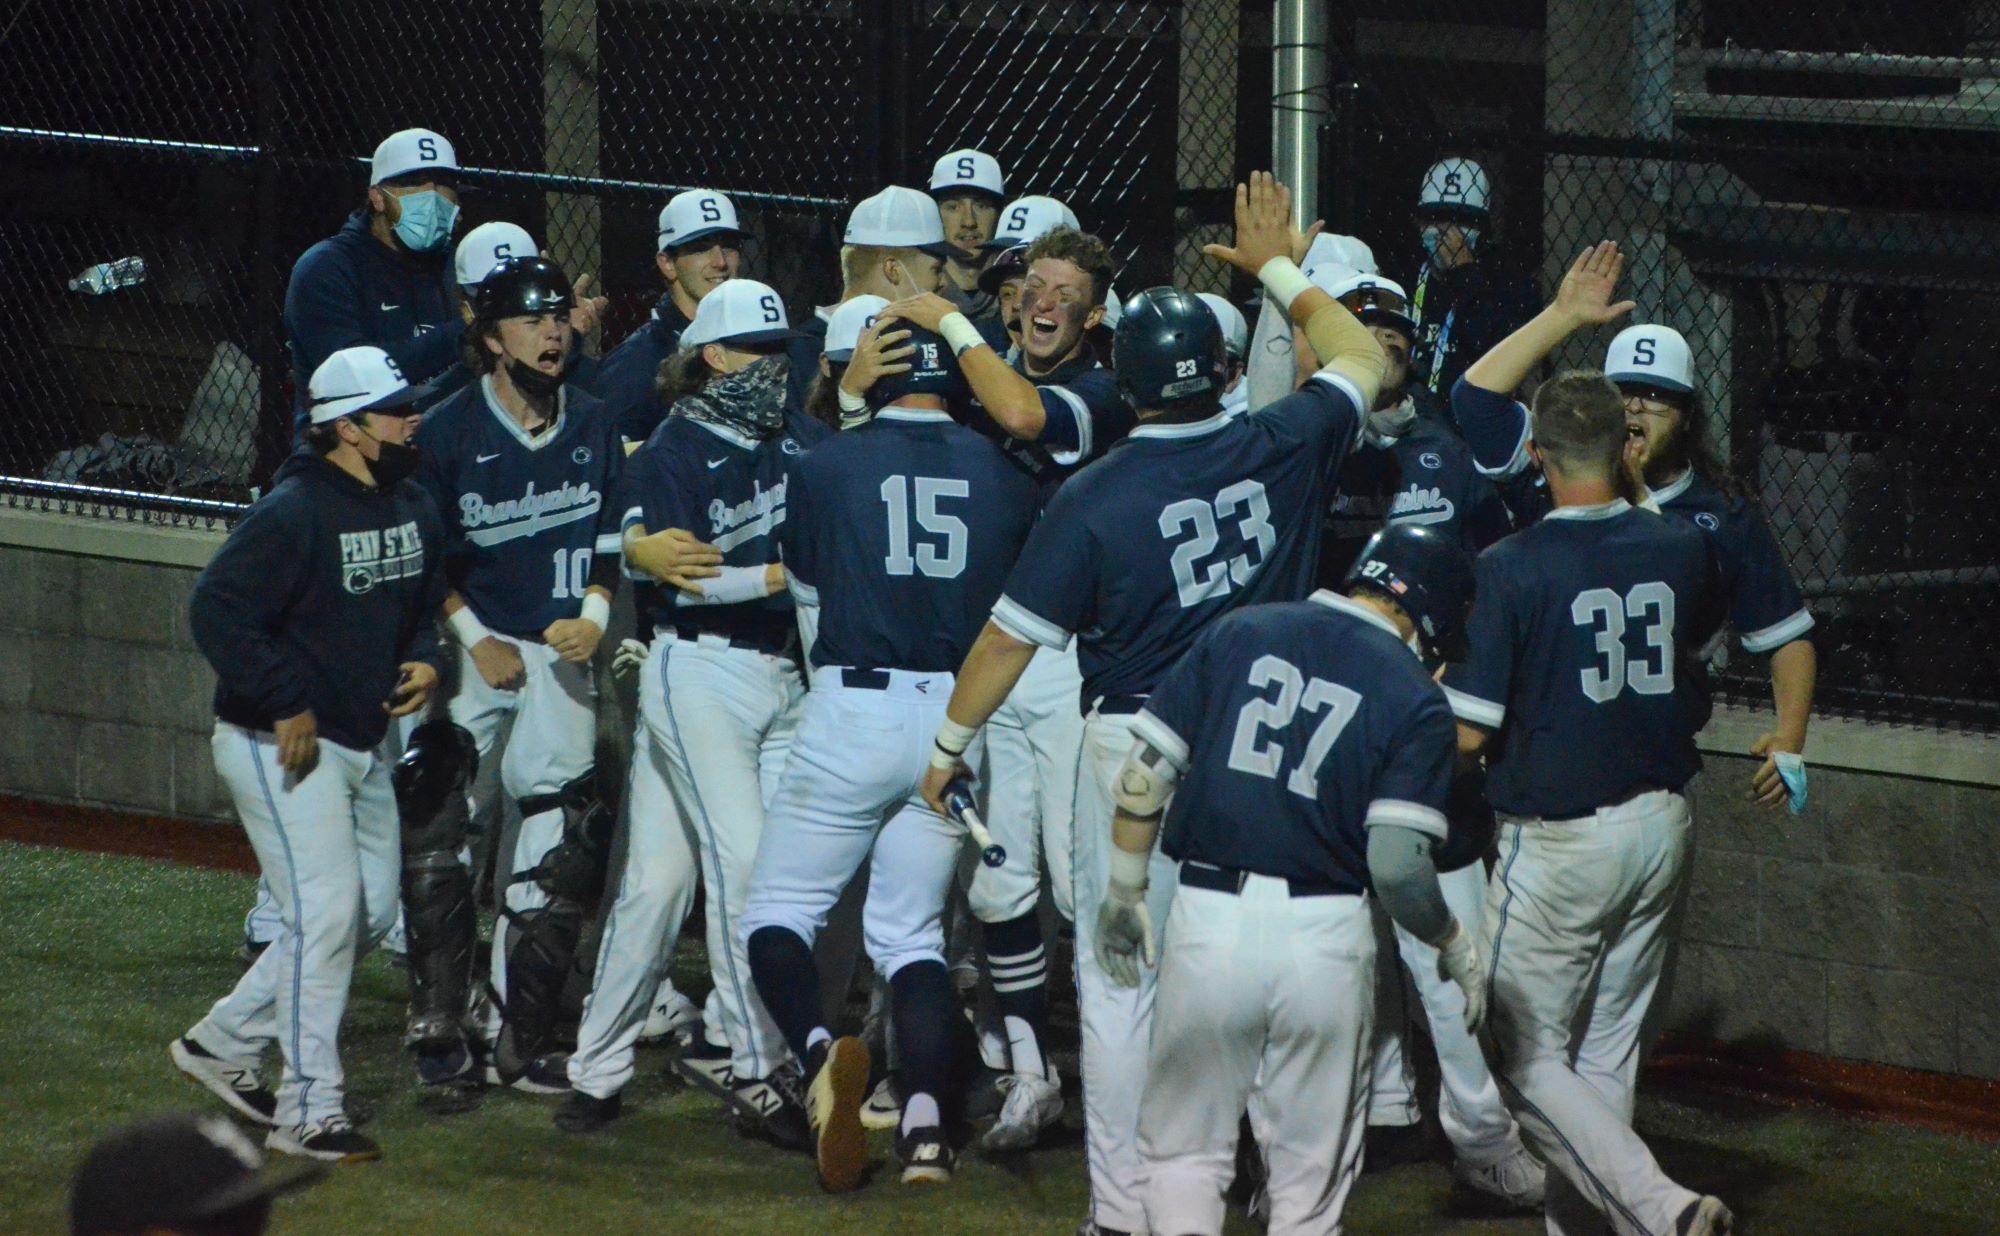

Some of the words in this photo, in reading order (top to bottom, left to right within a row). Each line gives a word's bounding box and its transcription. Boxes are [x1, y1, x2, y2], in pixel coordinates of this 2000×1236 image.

[418, 138, 437, 161] S
[957, 157, 976, 179] S
[1443, 173, 1461, 195] S
[700, 198, 721, 222] S
[1007, 207, 1029, 231] S
[760, 295, 780, 323] S
[921, 343, 938, 359] 15
[1633, 338, 1656, 366] S
[1175, 359, 1197, 378] 23
[459, 480, 601, 538] Brandywine
[880, 474, 969, 579] 15
[339, 530, 380, 562] PENN
[384, 521, 423, 557] STATE
[1158, 479, 1276, 608] 23
[552, 548, 593, 598] 10
[1362, 560, 1388, 577] 27
[1571, 581, 1675, 703] 33
[1227, 654, 1363, 800] 27
[751, 1089, 779, 1112] N
